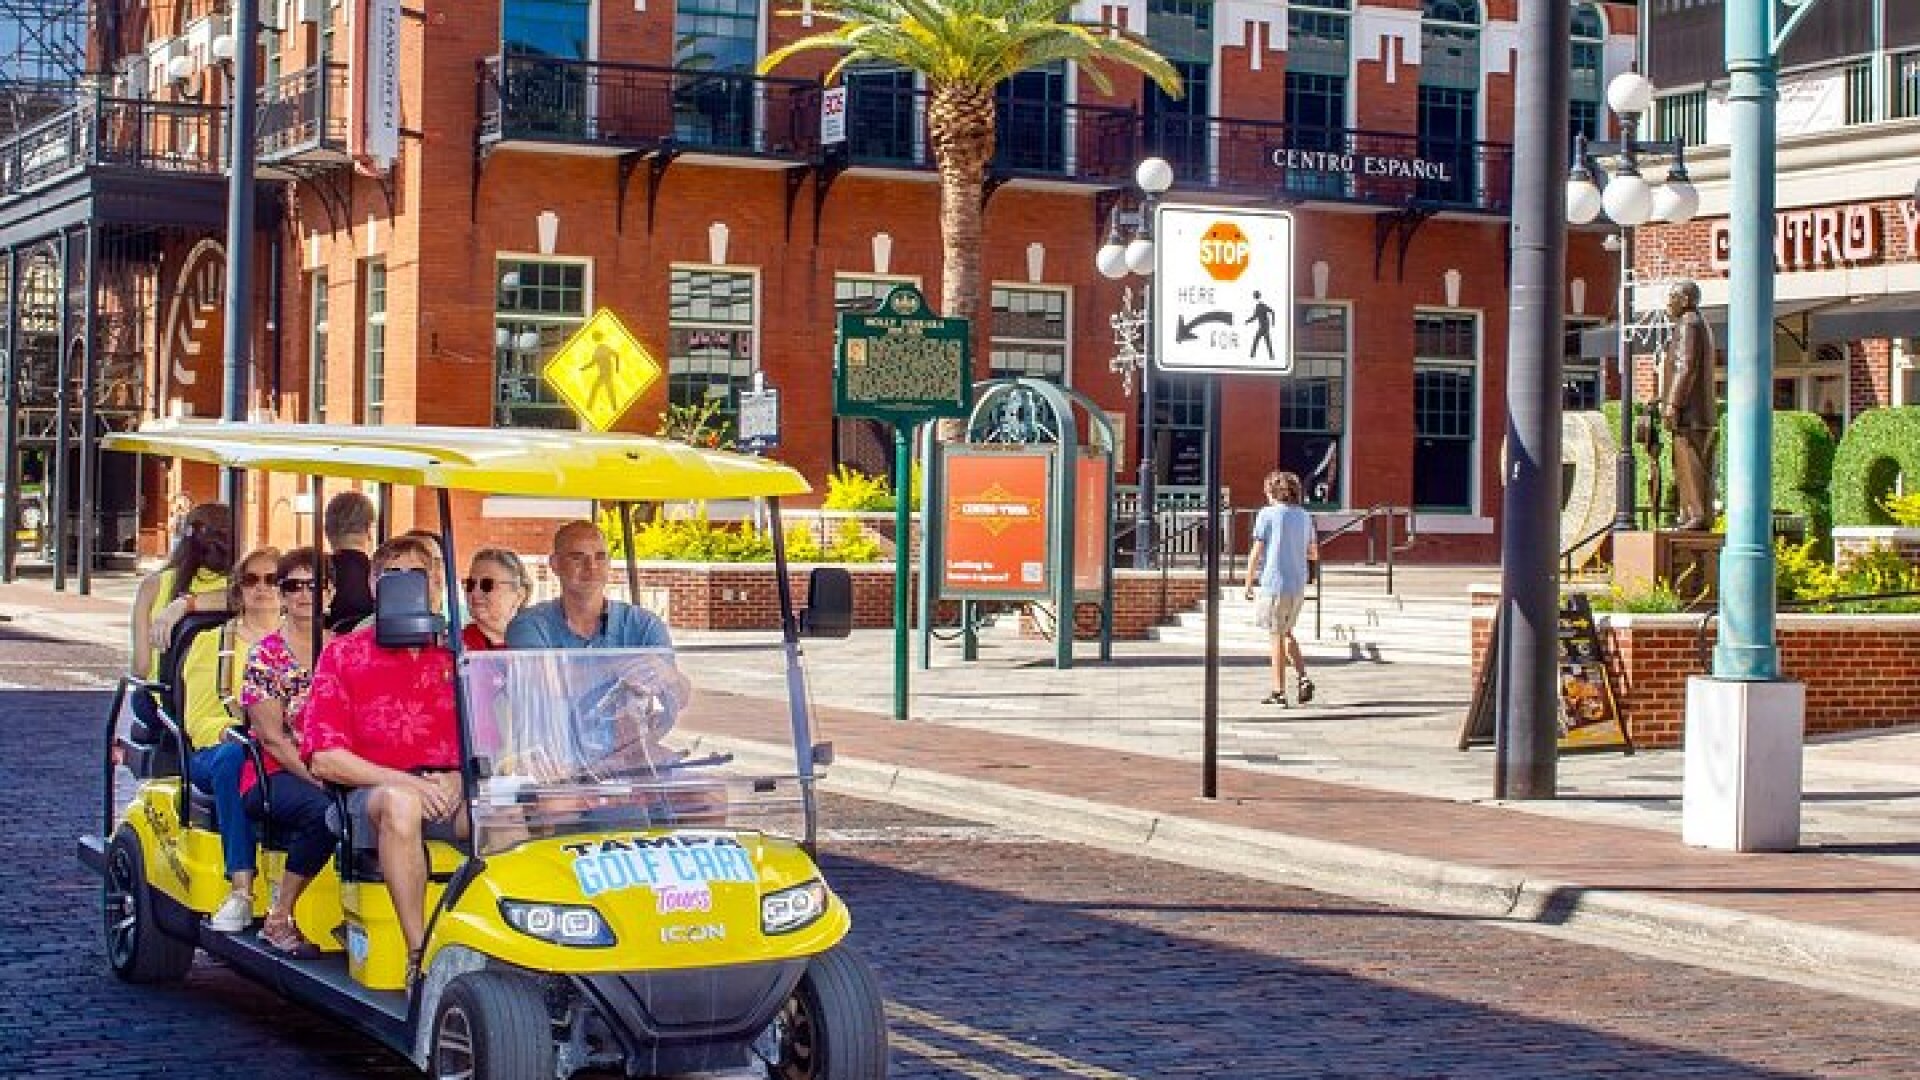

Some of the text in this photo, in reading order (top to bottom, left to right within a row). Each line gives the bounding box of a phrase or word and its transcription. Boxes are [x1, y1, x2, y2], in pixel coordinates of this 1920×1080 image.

[1272, 149, 1353, 172] CENTRO
[1711, 205, 1872, 270] CTRO
[1200, 240, 1248, 265] STOP
[1177, 286, 1217, 305] HERE
[1210, 331, 1239, 349] FOR
[561, 836, 748, 856] TAMPA
[573, 847, 757, 897] GOLF CART
[657, 885, 710, 915] Tours
[660, 923, 726, 943] ICON
